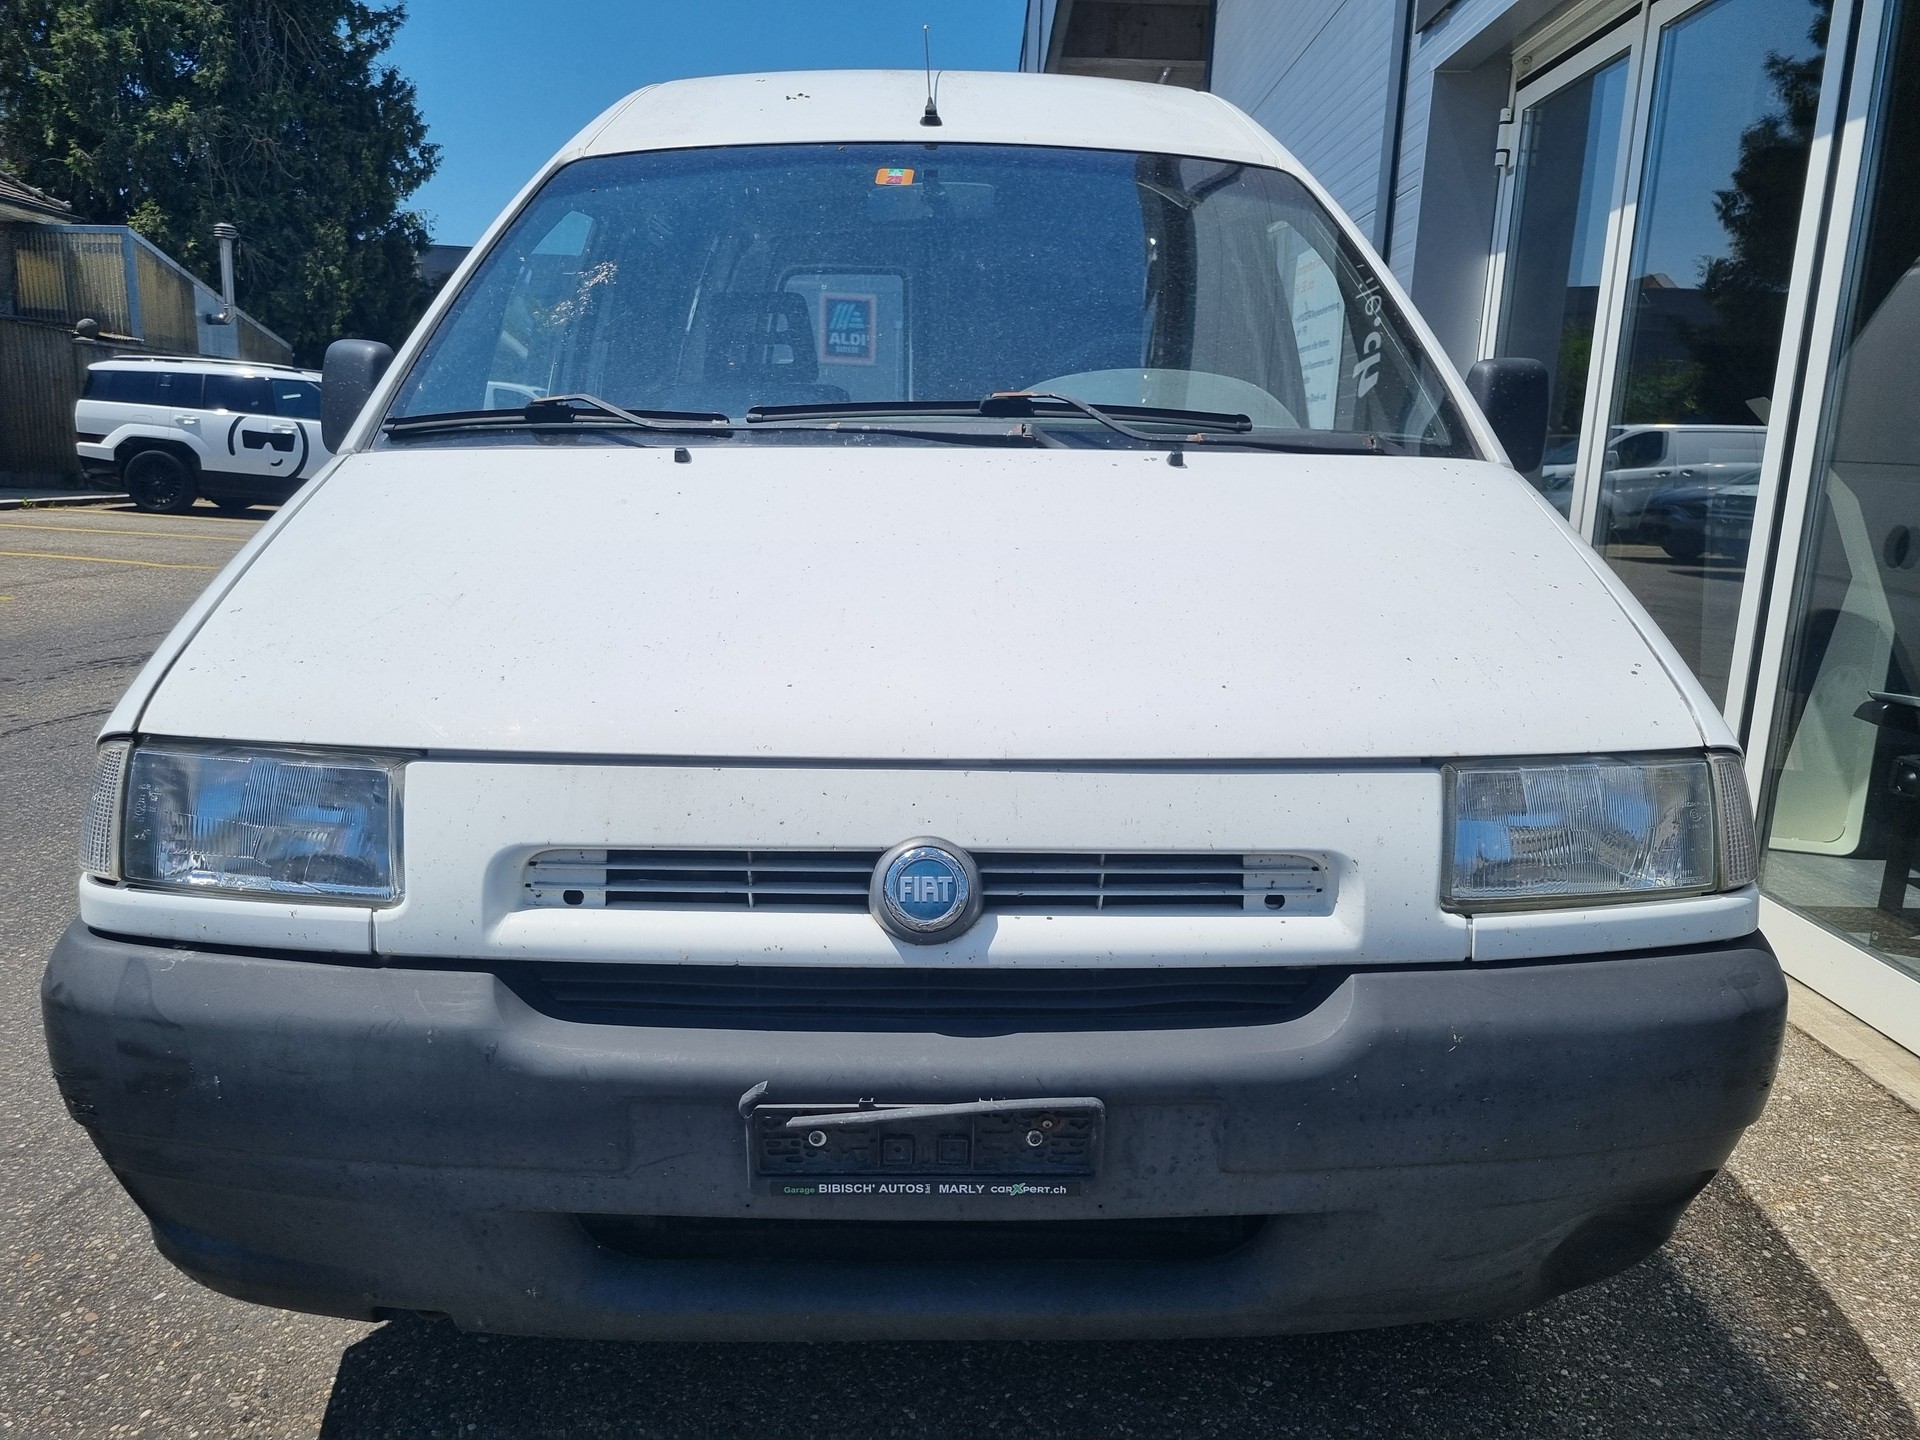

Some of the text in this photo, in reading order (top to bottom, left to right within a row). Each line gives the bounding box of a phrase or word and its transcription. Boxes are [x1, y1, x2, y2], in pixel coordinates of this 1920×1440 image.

[829, 332, 867, 346] ALDI
[899, 876, 953, 903] FIAT
[783, 1186, 816, 1195] Garage
[818, 1183, 876, 1194] BIBISCH'
[878, 1183, 925, 1194] AUTOS
[938, 1184, 985, 1194] MARLY
